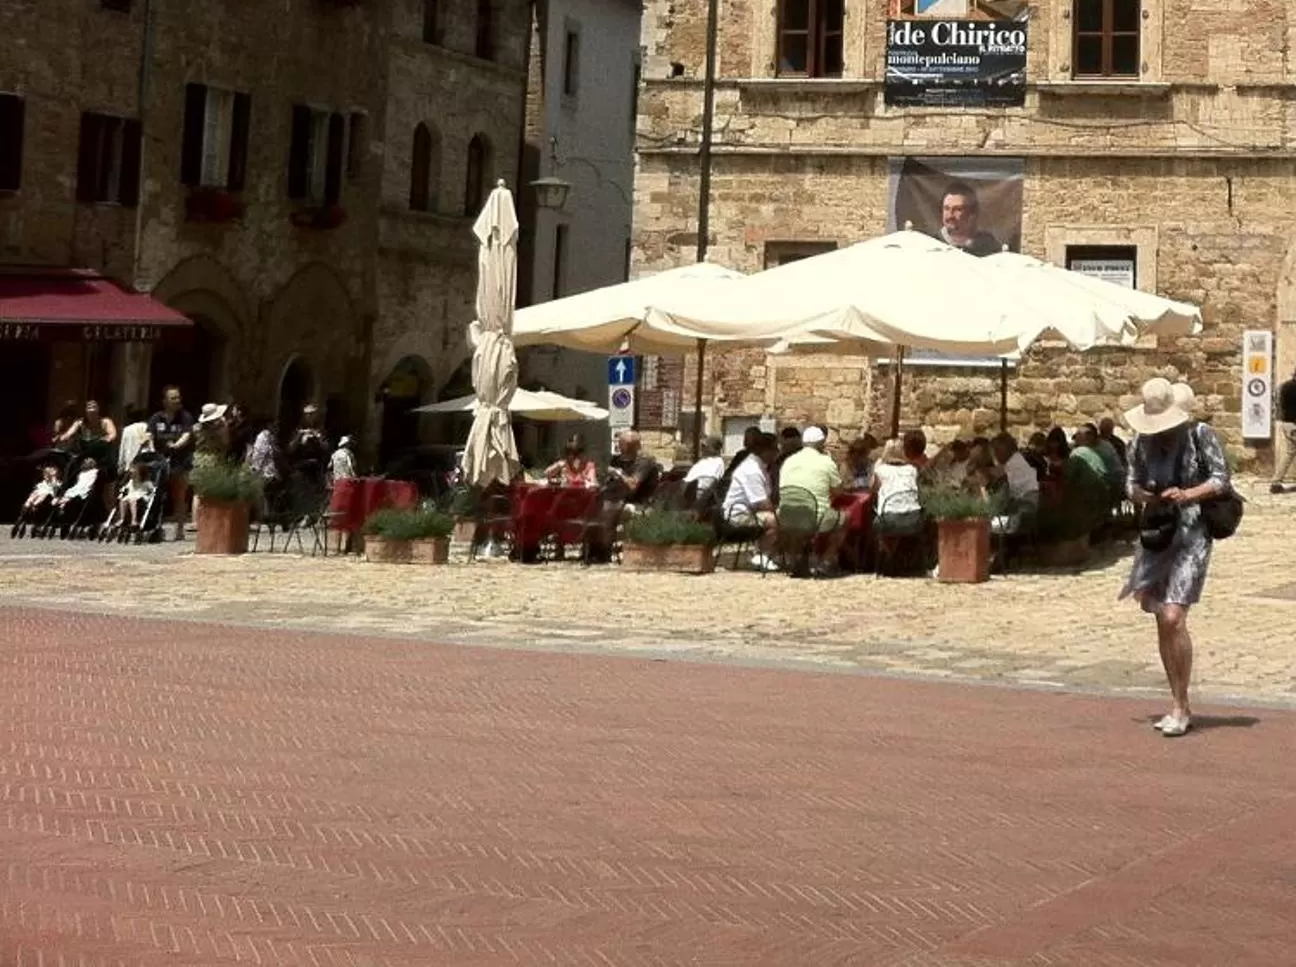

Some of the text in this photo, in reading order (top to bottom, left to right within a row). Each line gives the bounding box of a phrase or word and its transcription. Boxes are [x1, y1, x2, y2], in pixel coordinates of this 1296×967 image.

[894, 22, 926, 45] de
[931, 21, 1026, 46] Chirico
[888, 53, 981, 67] montepulciano
